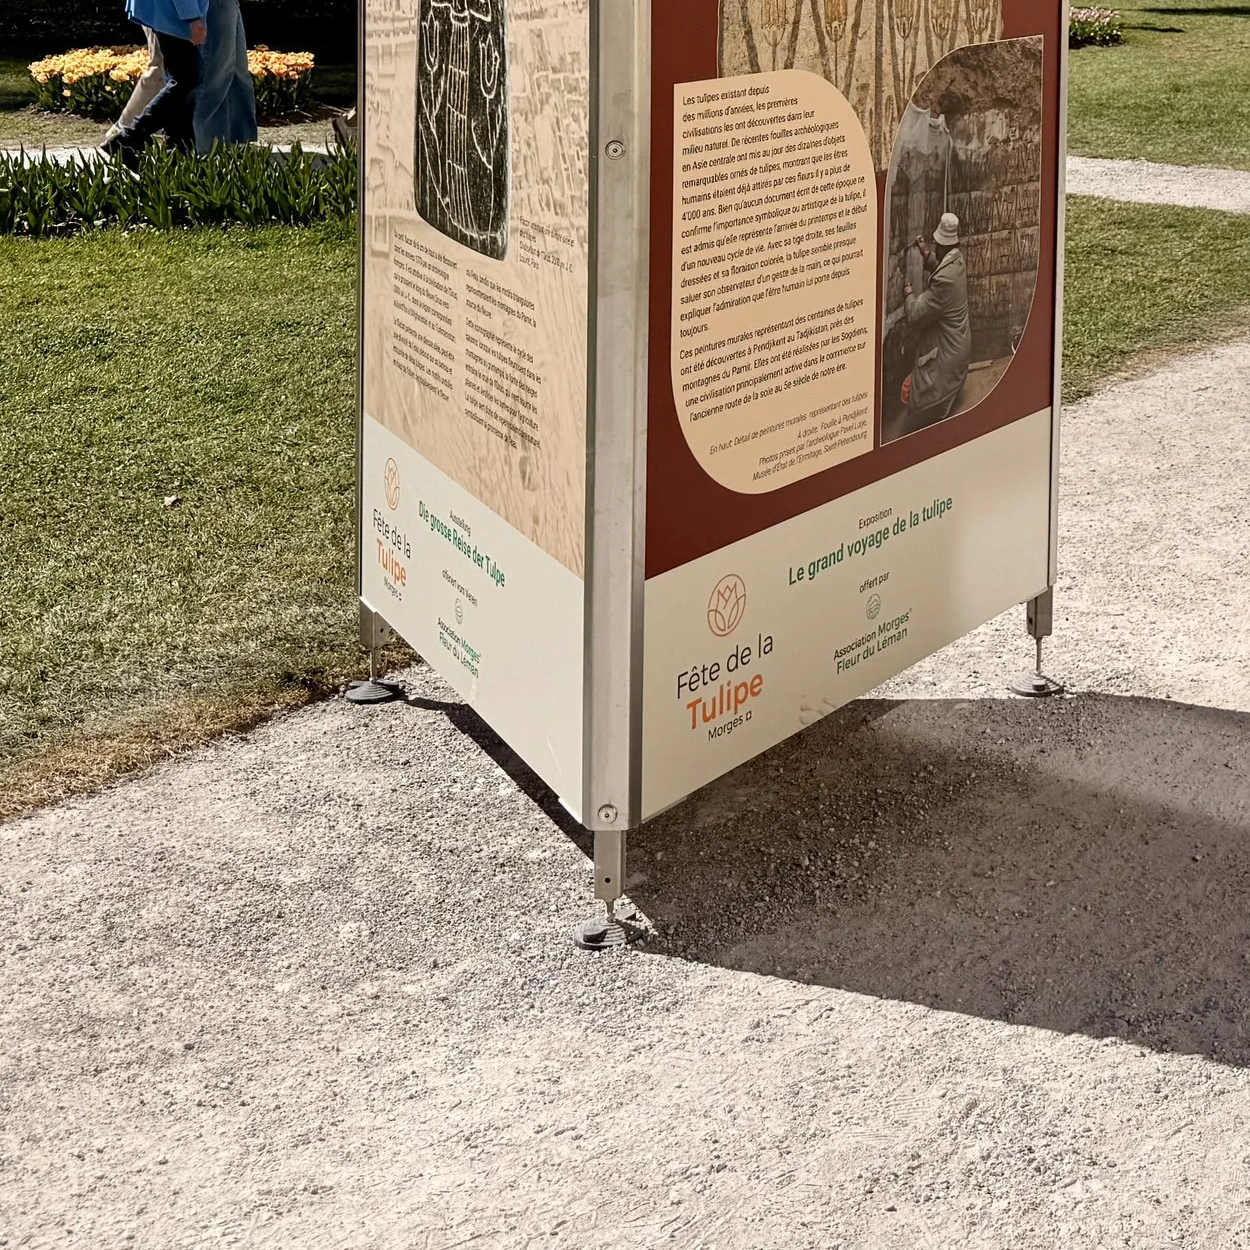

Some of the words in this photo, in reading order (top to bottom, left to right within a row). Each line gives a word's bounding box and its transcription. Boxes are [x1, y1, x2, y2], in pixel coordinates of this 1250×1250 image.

[683, 97, 695, 105] Les
[697, 93, 719, 103] tulipes
[748, 85, 769, 96] depuis
[683, 113, 695, 122] des
[697, 109, 723, 119] millions
[756, 102, 766, 110] les
[767, 97, 798, 111] premières
[682, 126, 722, 139] civilisations
[724, 123, 733, 132] les
[735, 121, 745, 130] ont
[747, 115, 786, 128] découvertes
[787, 112, 802, 121] dans
[803, 110, 814, 118] leur
[731, 138, 740, 147] De
[742, 134, 769, 145] récentes
[770, 129, 793, 139] fouilles
[794, 122, 839, 136] archéologiques
[682, 164, 691, 172] en
[692, 160, 708, 170] Asie
[709, 154, 735, 167] centrale
[737, 153, 747, 162] ont
[749, 150, 761, 159] mis
[771, 147, 784, 157] jour
[785, 144, 796, 153] des
[797, 140, 822, 150] dizaines
[682, 172, 728, 189] remarquables
[730, 168, 748, 179] ornés
[749, 166, 757, 175] de
[759, 163, 781, 173] tulipes,
[783, 157, 810, 169] montrant
[811, 155, 823, 165] que
[824, 152, 832, 160] les
[834, 150, 848, 159] êtres
[682, 193, 711, 205] humains
[713, 187, 735, 199] étaient
[737, 183, 750, 194] déjà
[752, 179, 772, 191] attirés
[773, 178, 783, 188] par
[785, 176, 796, 184] ces
[797, 172, 814, 181] fleurs
[830, 166, 842, 176] plus
[702, 208, 716, 217] ans.
[718, 204, 732, 214] Bien
[734, 198, 763, 211] qu'aucun
[764, 190, 795, 204] document
[797, 187, 810, 197] écrit
[820, 183, 834, 192] cette
[836, 178, 857, 190] époque
[680, 350, 693, 359] Ces
[695, 340, 726, 357] peintures
[727, 332, 753, 345] murales
[755, 319, 794, 337] représentant
[795, 316, 806, 325] des
[807, 307, 835, 321] centaines
[845, 299, 863, 310] tulipes
[681, 365, 692, 376] ont
[693, 360, 704, 372] été
[706, 350, 746, 368] découvertes
[830, 319, 843, 331] près
[844, 316, 854, 325] des
[373, 509, 389, 539] Fête
[391, 526, 401, 550] de
[404, 534, 411, 559] la
[859, 507, 892, 529] Exposition
[419, 500, 429, 522] Die
[430, 514, 451, 542] grosse
[453, 528, 471, 558] Reise
[472, 546, 484, 569] der
[485, 555, 505, 587] Tulpe
[789, 566, 804, 585] Le
[808, 543, 843, 581] grand
[847, 527, 889, 557] voyage
[892, 517, 906, 536] de
[910, 511, 919, 528] la
[922, 497, 952, 521] tulipe
[377, 538, 406, 587] Tulipe
[859, 577, 878, 593] offert
[878, 571, 889, 586] par
[834, 631, 876, 660] Association
[837, 653, 860, 674] Fleur
[863, 646, 874, 659] du
[877, 628, 907, 652] Léman
[678, 663, 720, 699] Fête
[727, 645, 751, 672] de
[759, 633, 773, 658] la
[687, 674, 763, 730] Tulipe
[708, 715, 743, 742] Morges
